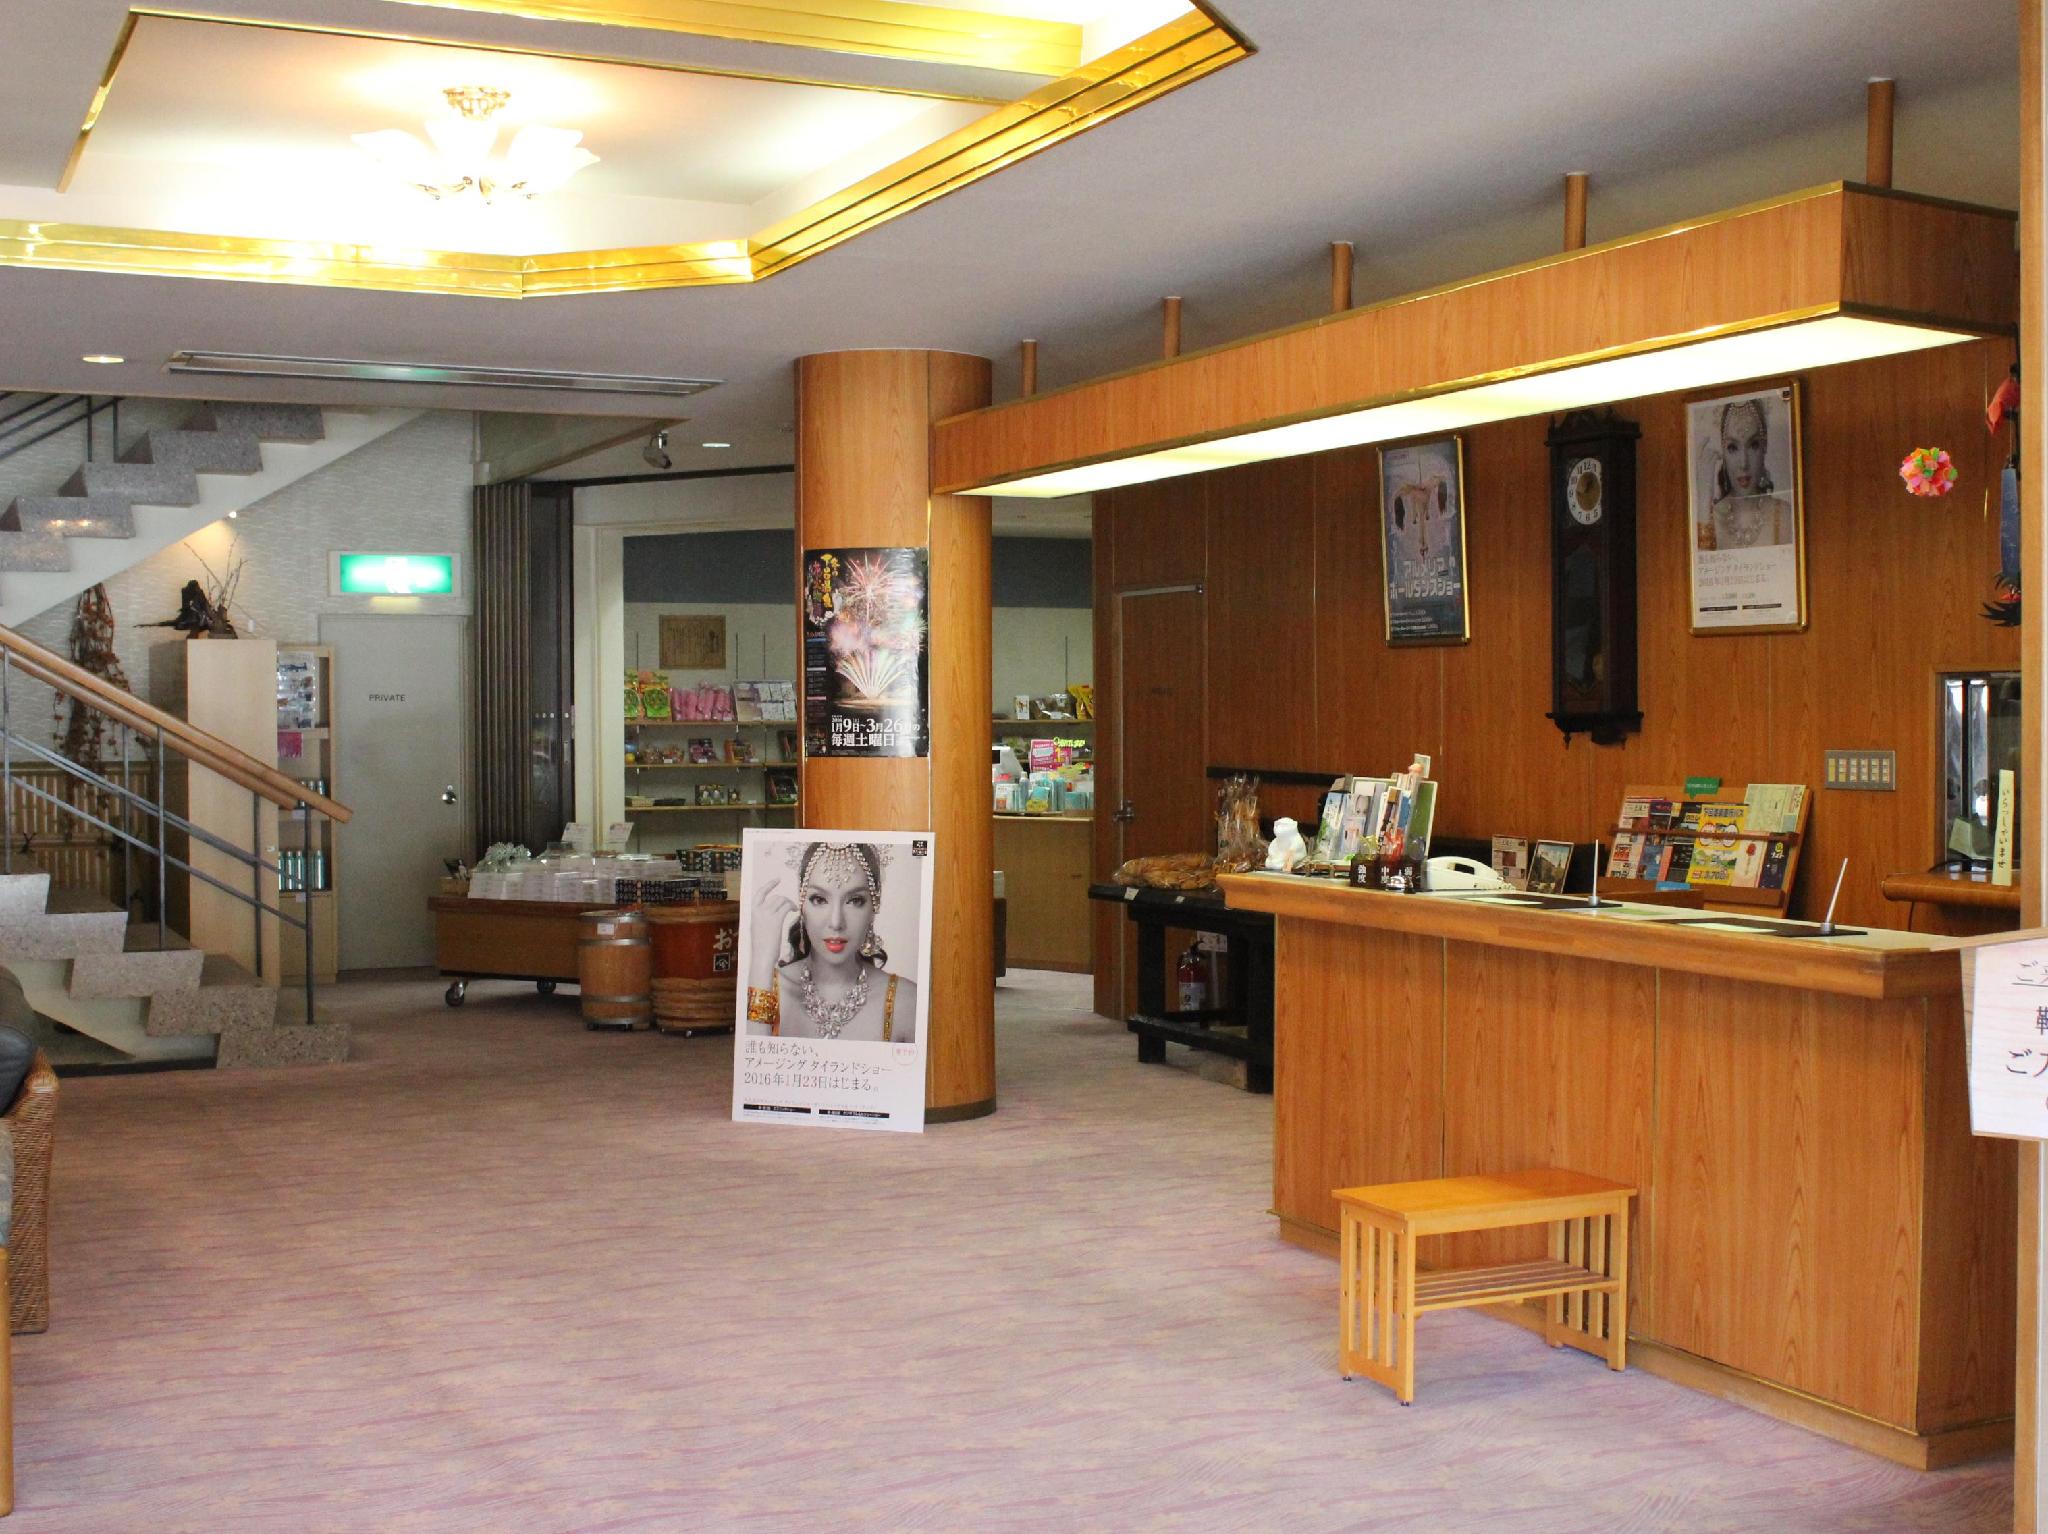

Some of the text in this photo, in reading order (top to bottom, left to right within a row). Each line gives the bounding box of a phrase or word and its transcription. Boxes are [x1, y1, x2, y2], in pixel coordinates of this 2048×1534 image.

[368, 693, 406, 702] PRIVATE
[831, 733, 895, 747] 毎週土曜日
[744, 1056, 893, 1076] アメージング タイランドショー
